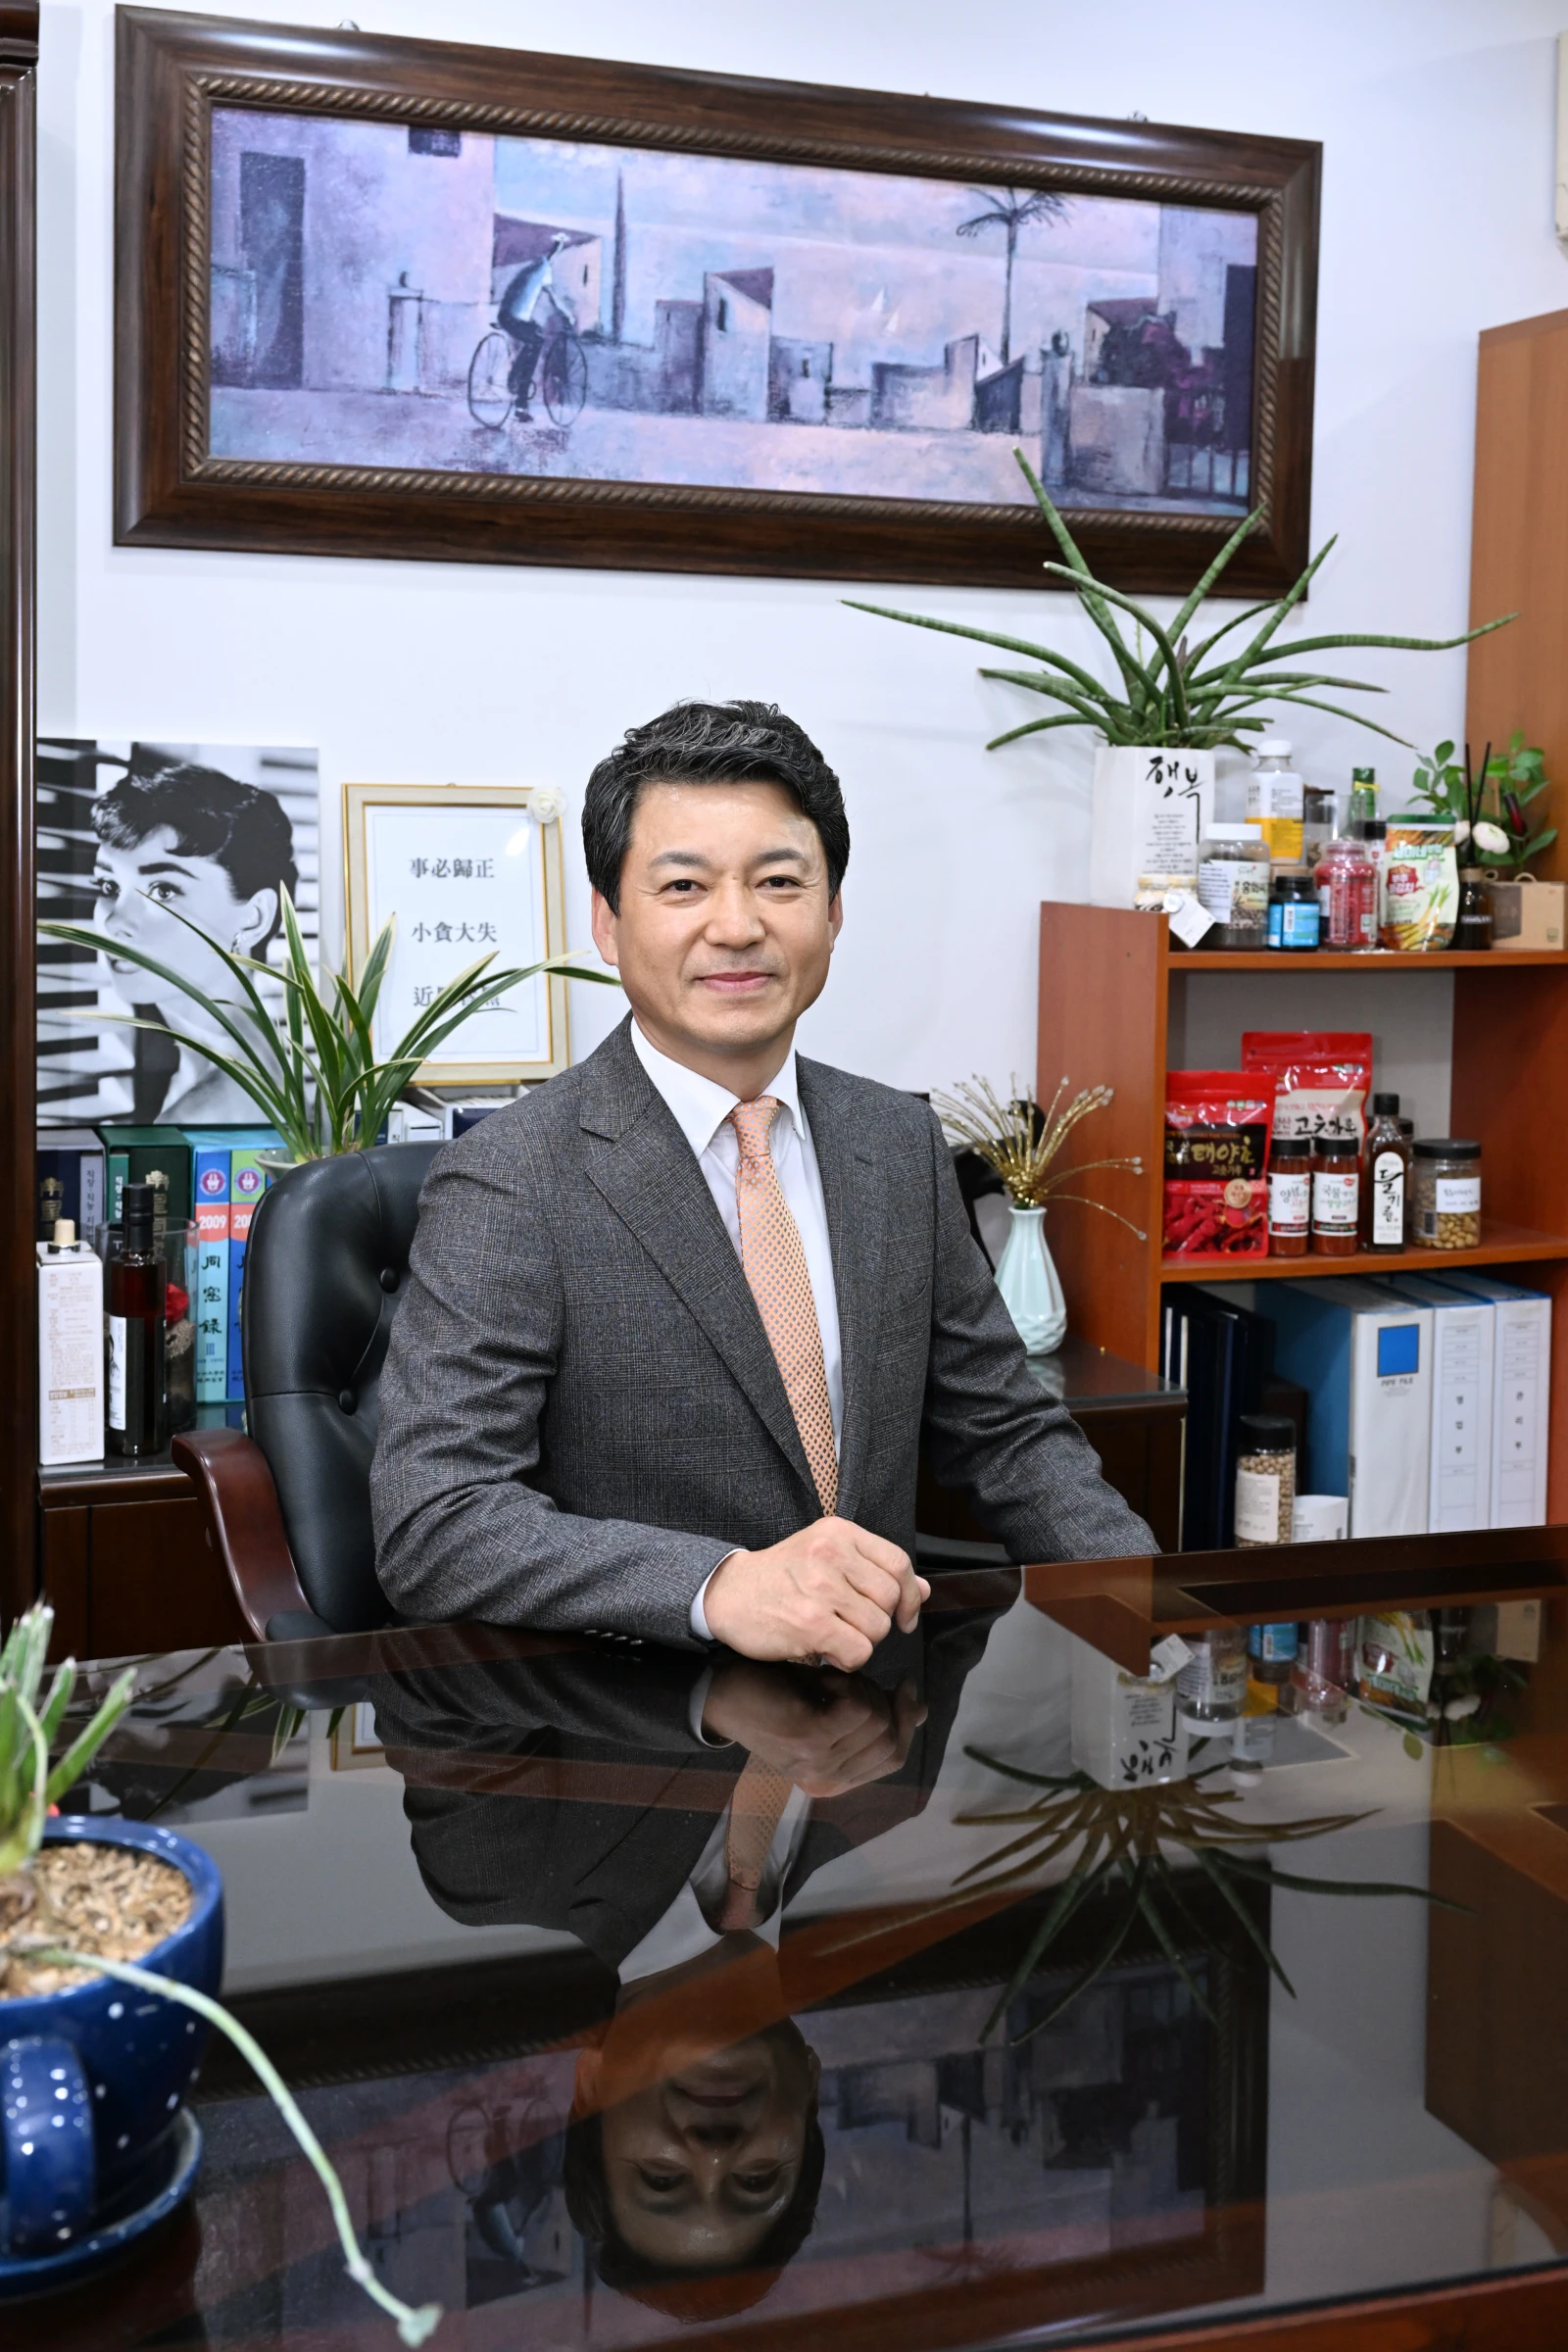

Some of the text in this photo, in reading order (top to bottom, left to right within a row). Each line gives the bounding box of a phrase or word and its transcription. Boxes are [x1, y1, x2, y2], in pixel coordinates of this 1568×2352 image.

[409, 857, 495, 879] 事必歸正
[1191, 1136, 1255, 1164] 태양초
[199, 1214, 226, 1230] 2009
